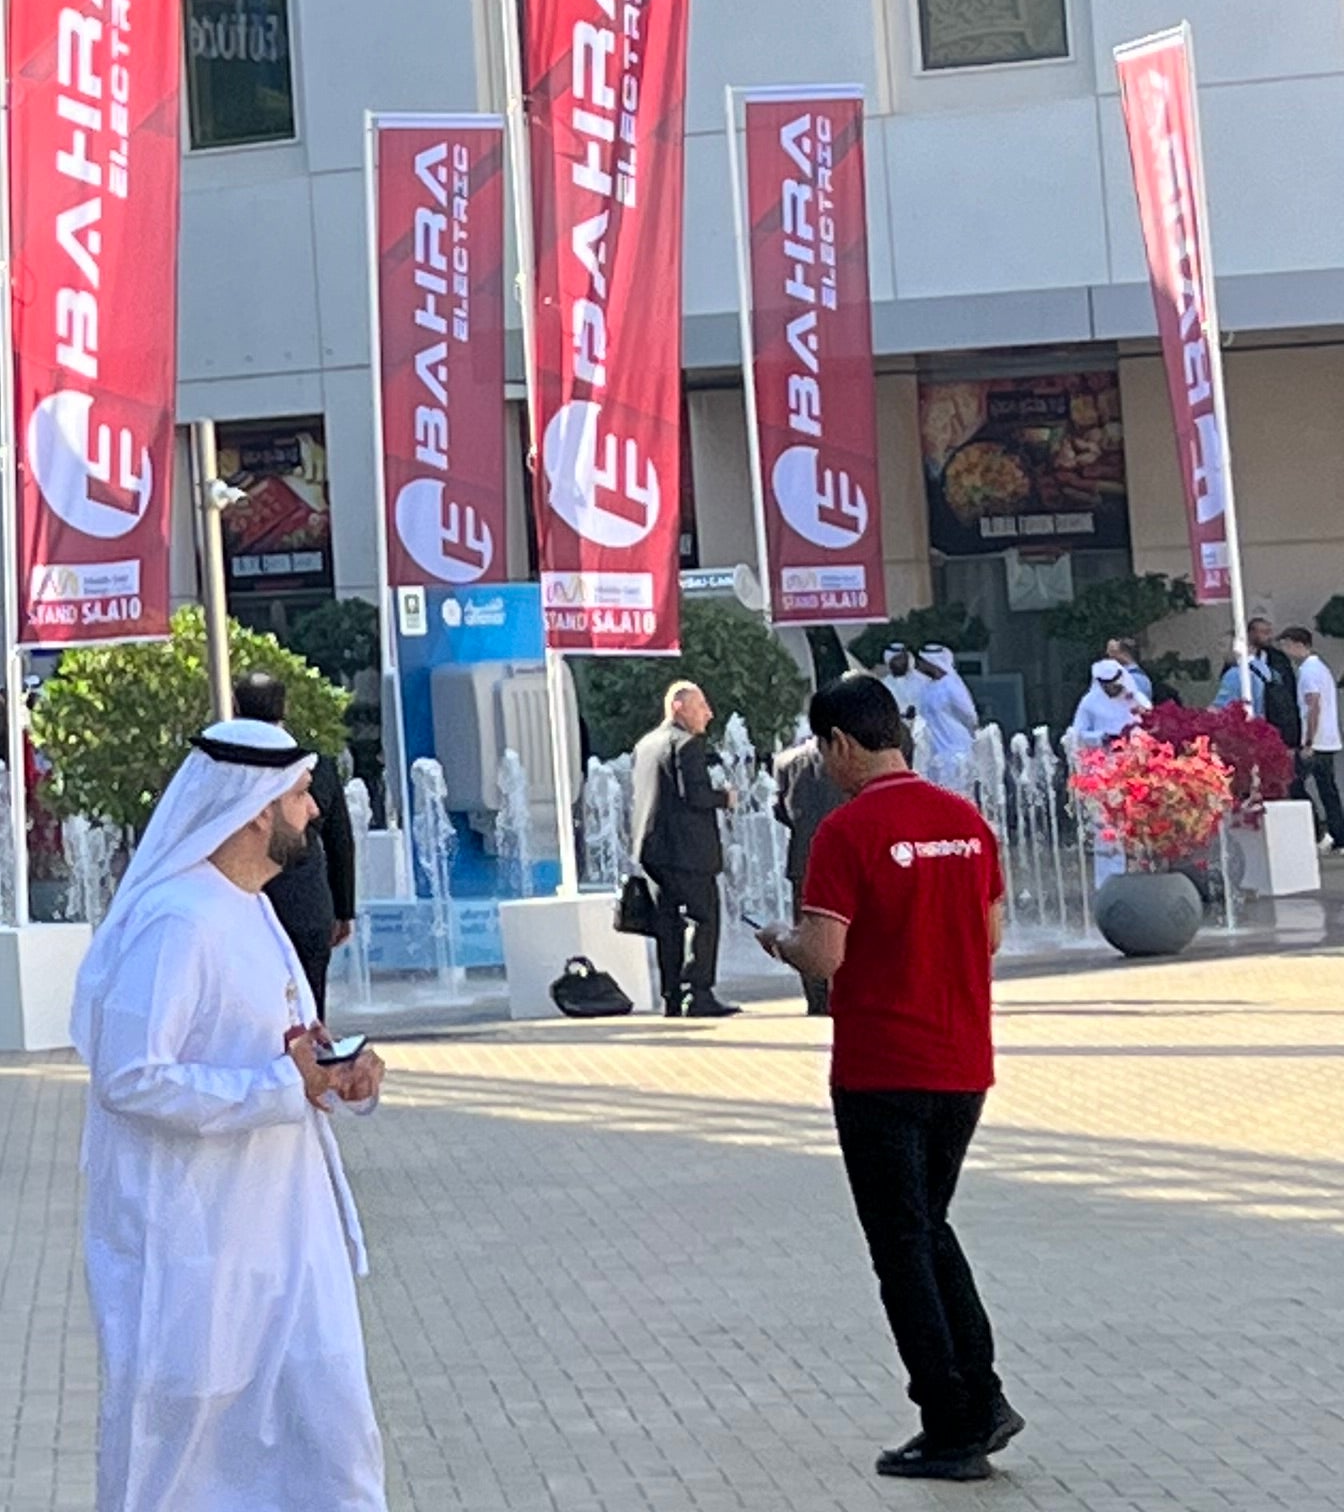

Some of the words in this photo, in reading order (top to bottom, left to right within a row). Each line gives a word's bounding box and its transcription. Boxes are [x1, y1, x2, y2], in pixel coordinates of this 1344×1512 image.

[413, 141, 449, 471] BAHRA
[451, 144, 472, 344] ELECTRIC
[779, 112, 822, 439] BAHRA
[815, 115, 837, 312] ELECTRIC
